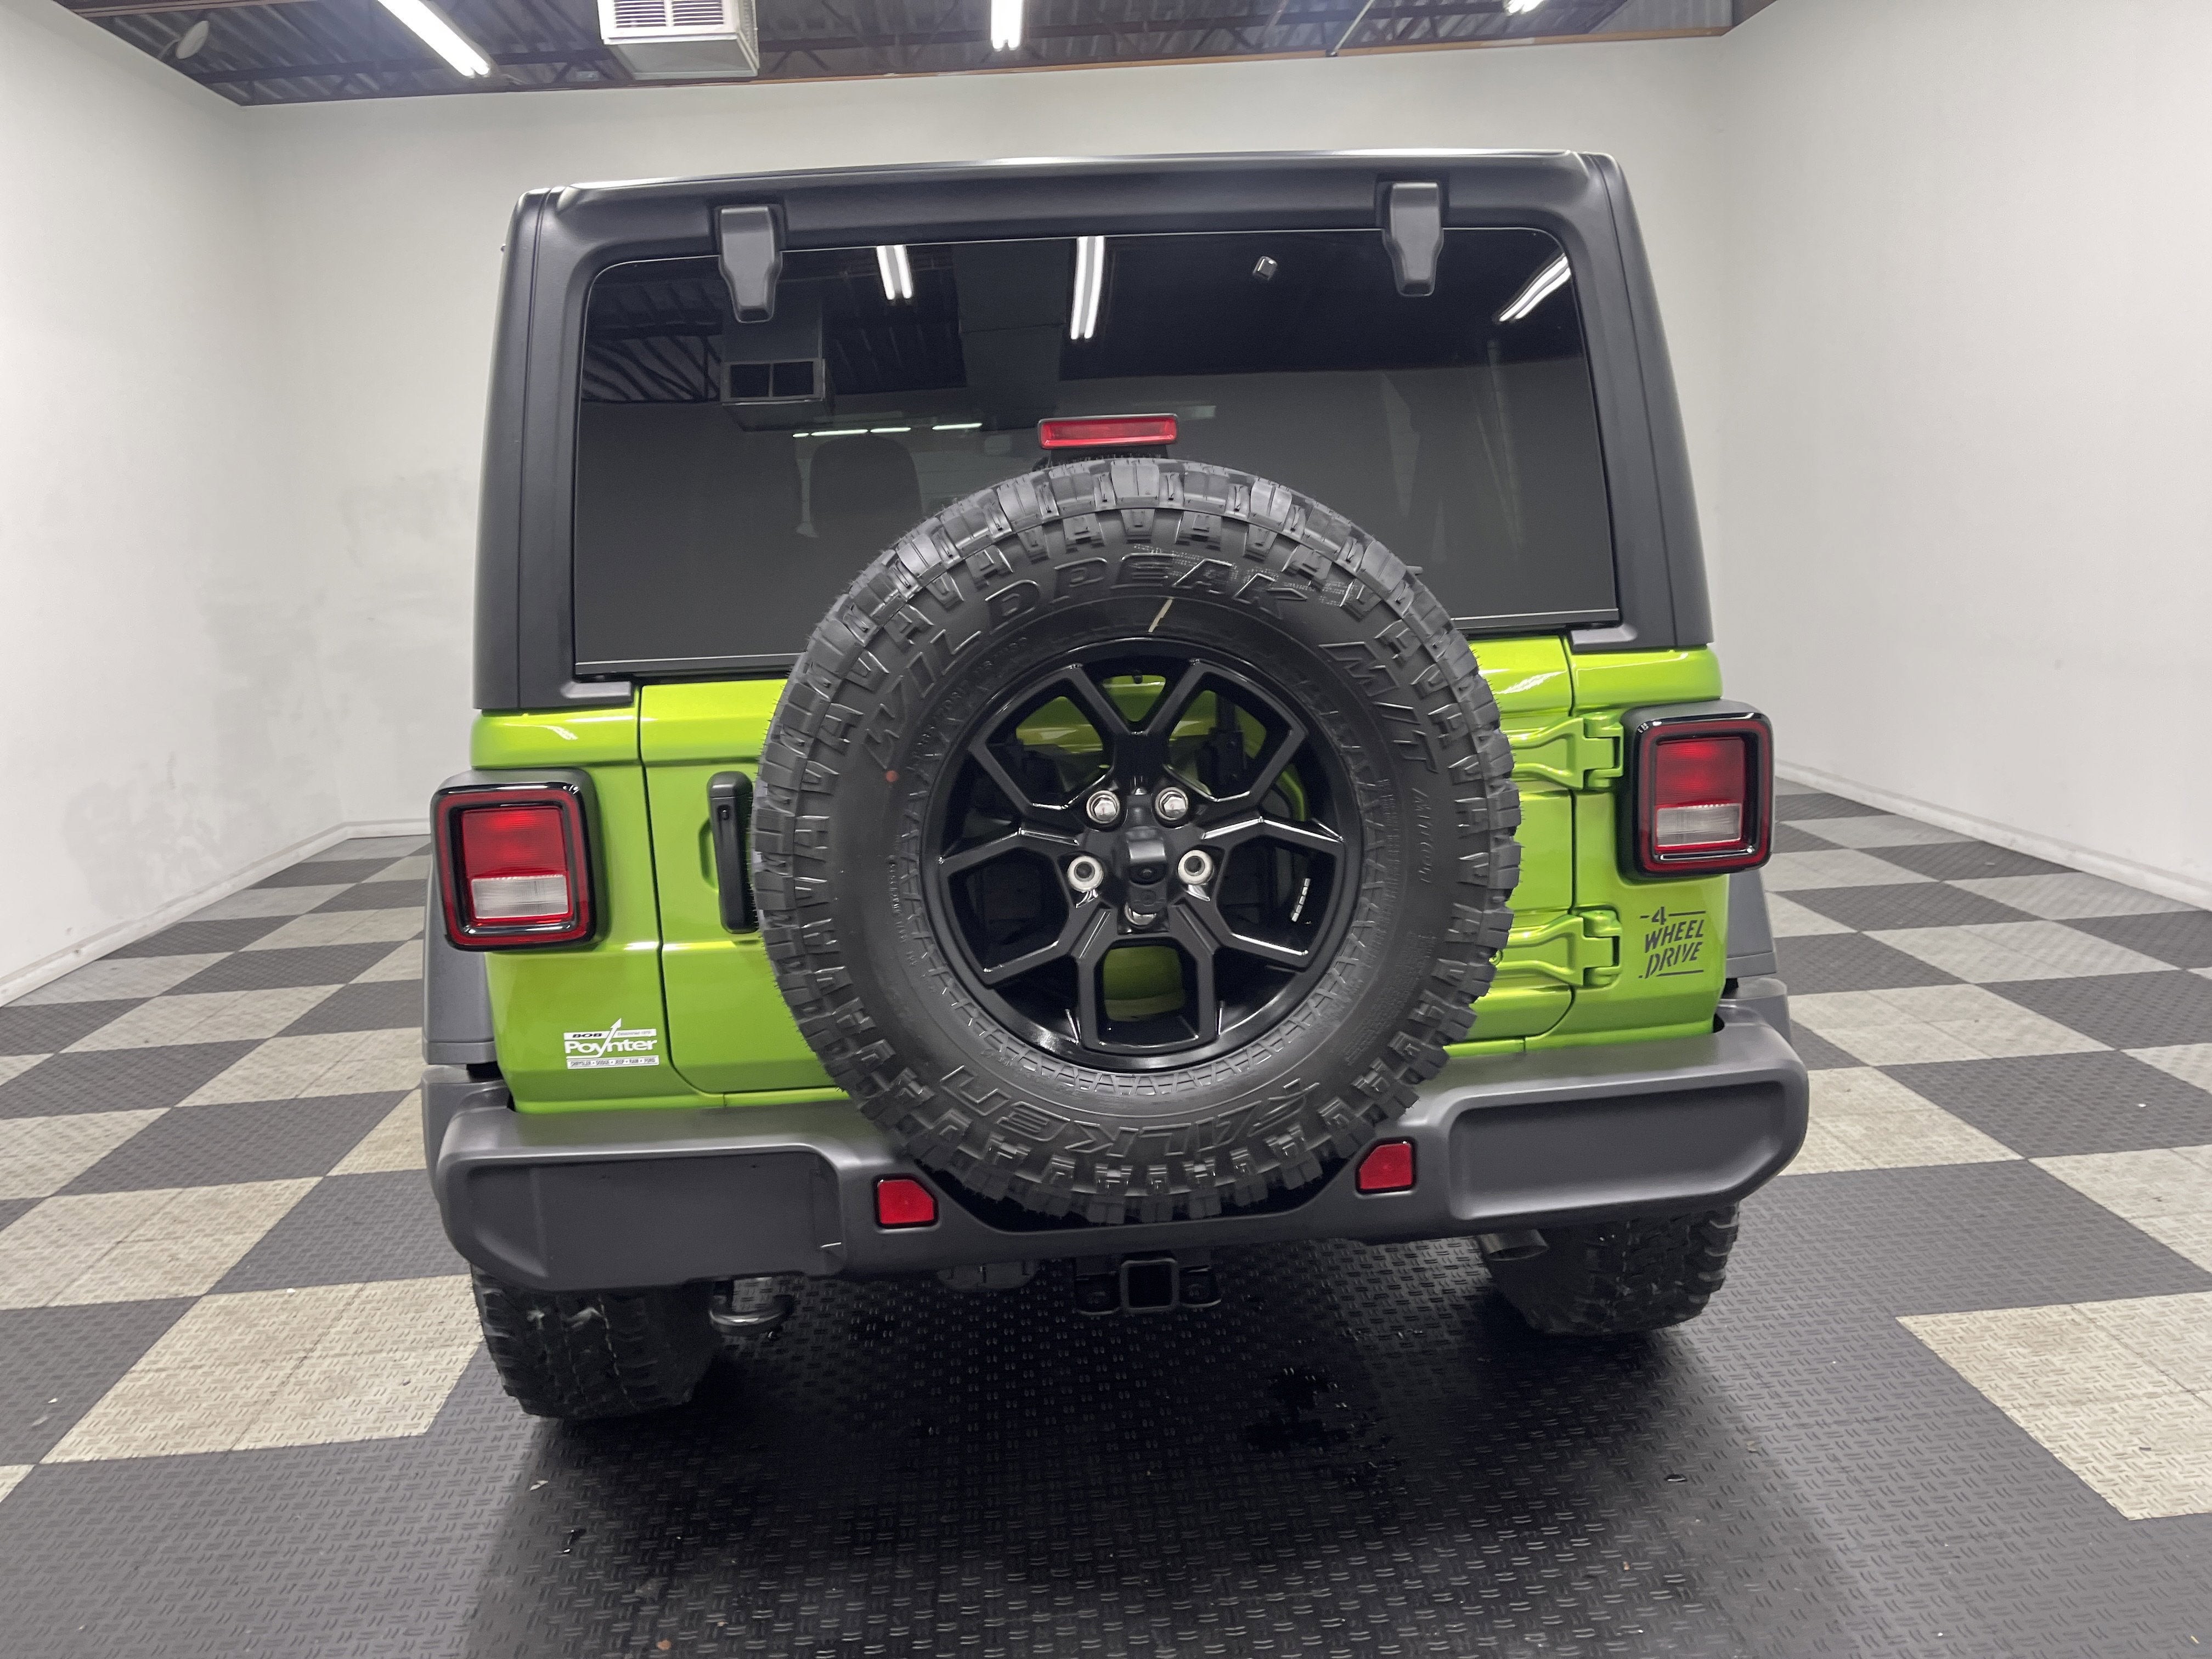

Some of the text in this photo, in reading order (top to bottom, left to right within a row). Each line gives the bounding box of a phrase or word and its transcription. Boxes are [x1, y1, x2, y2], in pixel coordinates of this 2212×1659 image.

[862, 551, 1308, 770] WILDPEAK
[1651, 906, 1667, 925] 4
[1645, 919, 1704, 953] WHEEL
[1645, 941, 1703, 979] DRIVE
[565, 1039, 657, 1057] Poynter
